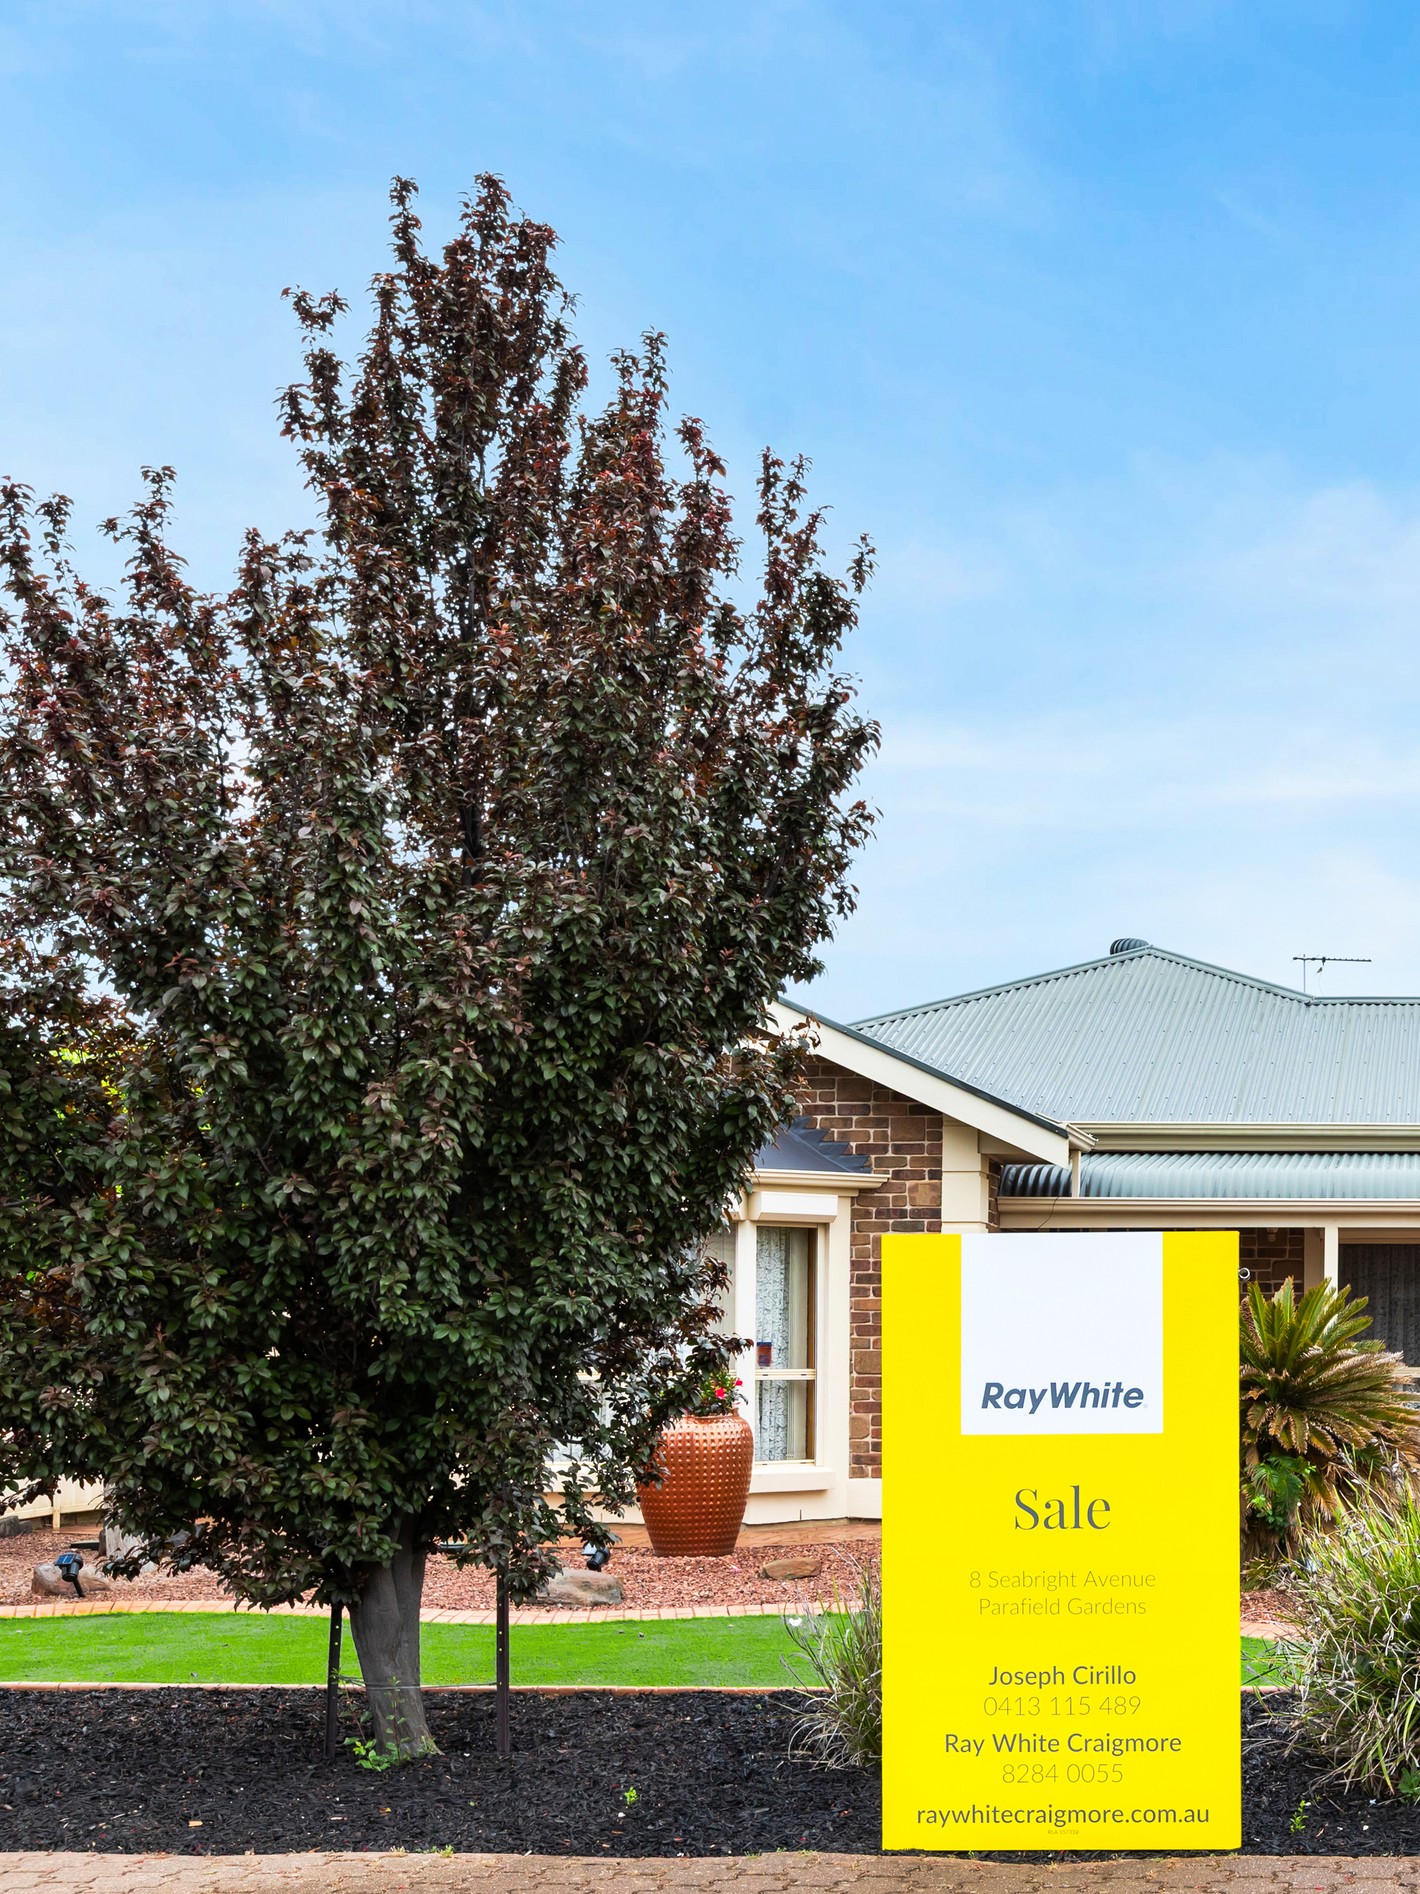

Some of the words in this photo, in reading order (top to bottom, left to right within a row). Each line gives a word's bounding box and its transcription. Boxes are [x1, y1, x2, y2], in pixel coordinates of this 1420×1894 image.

[1014, 1484, 1111, 1531] Sale
[969, 1570, 982, 1589] 8
[987, 1570, 1078, 1592] Seabright
[1083, 1570, 1156, 1588] Avenue
[979, 1597, 1061, 1616] Parafield
[1067, 1597, 1147, 1616] Gardens
[988, 1665, 1066, 1689] Joseph
[1072, 1665, 1137, 1686] Cirillo
[983, 1696, 1041, 1717] 0413
[1049, 1696, 1091, 1716] 115
[1098, 1695, 1142, 1716] 489
[945, 1733, 986, 1757] Ray
[991, 1733, 1061, 1753] White
[1066, 1732, 1182, 1757] Craigmore
[1002, 1763, 1060, 1784] 8284
[1066, 1763, 1124, 1784] 0055
[917, 1803, 1210, 1828] raywhitecraigmore.com.au
